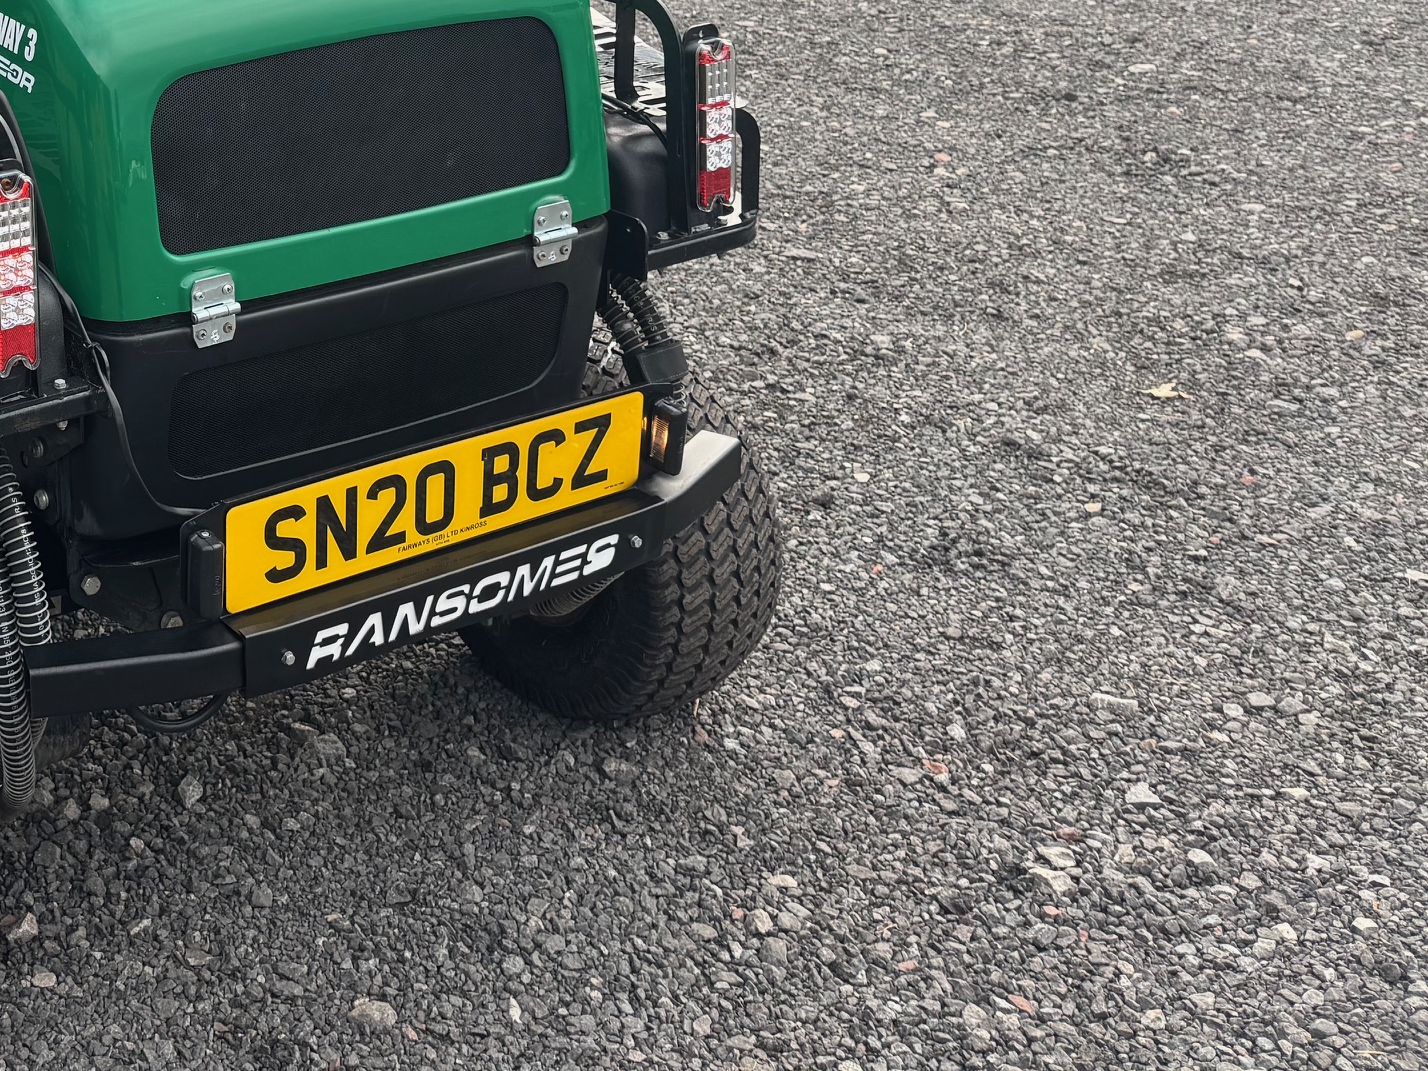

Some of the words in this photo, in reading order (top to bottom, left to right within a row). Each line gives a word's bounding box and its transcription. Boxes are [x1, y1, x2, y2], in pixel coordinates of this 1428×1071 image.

[24, 28, 38, 62] 3
[264, 459, 456, 584] SN20
[479, 412, 612, 520] BCZ
[397, 538, 430, 553] FAIRWAYS
[431, 534, 446, 544] (GB)
[446, 529, 459, 538] LTD
[459, 521, 488, 533] KINROSS
[305, 533, 620, 670] RANSOMES
